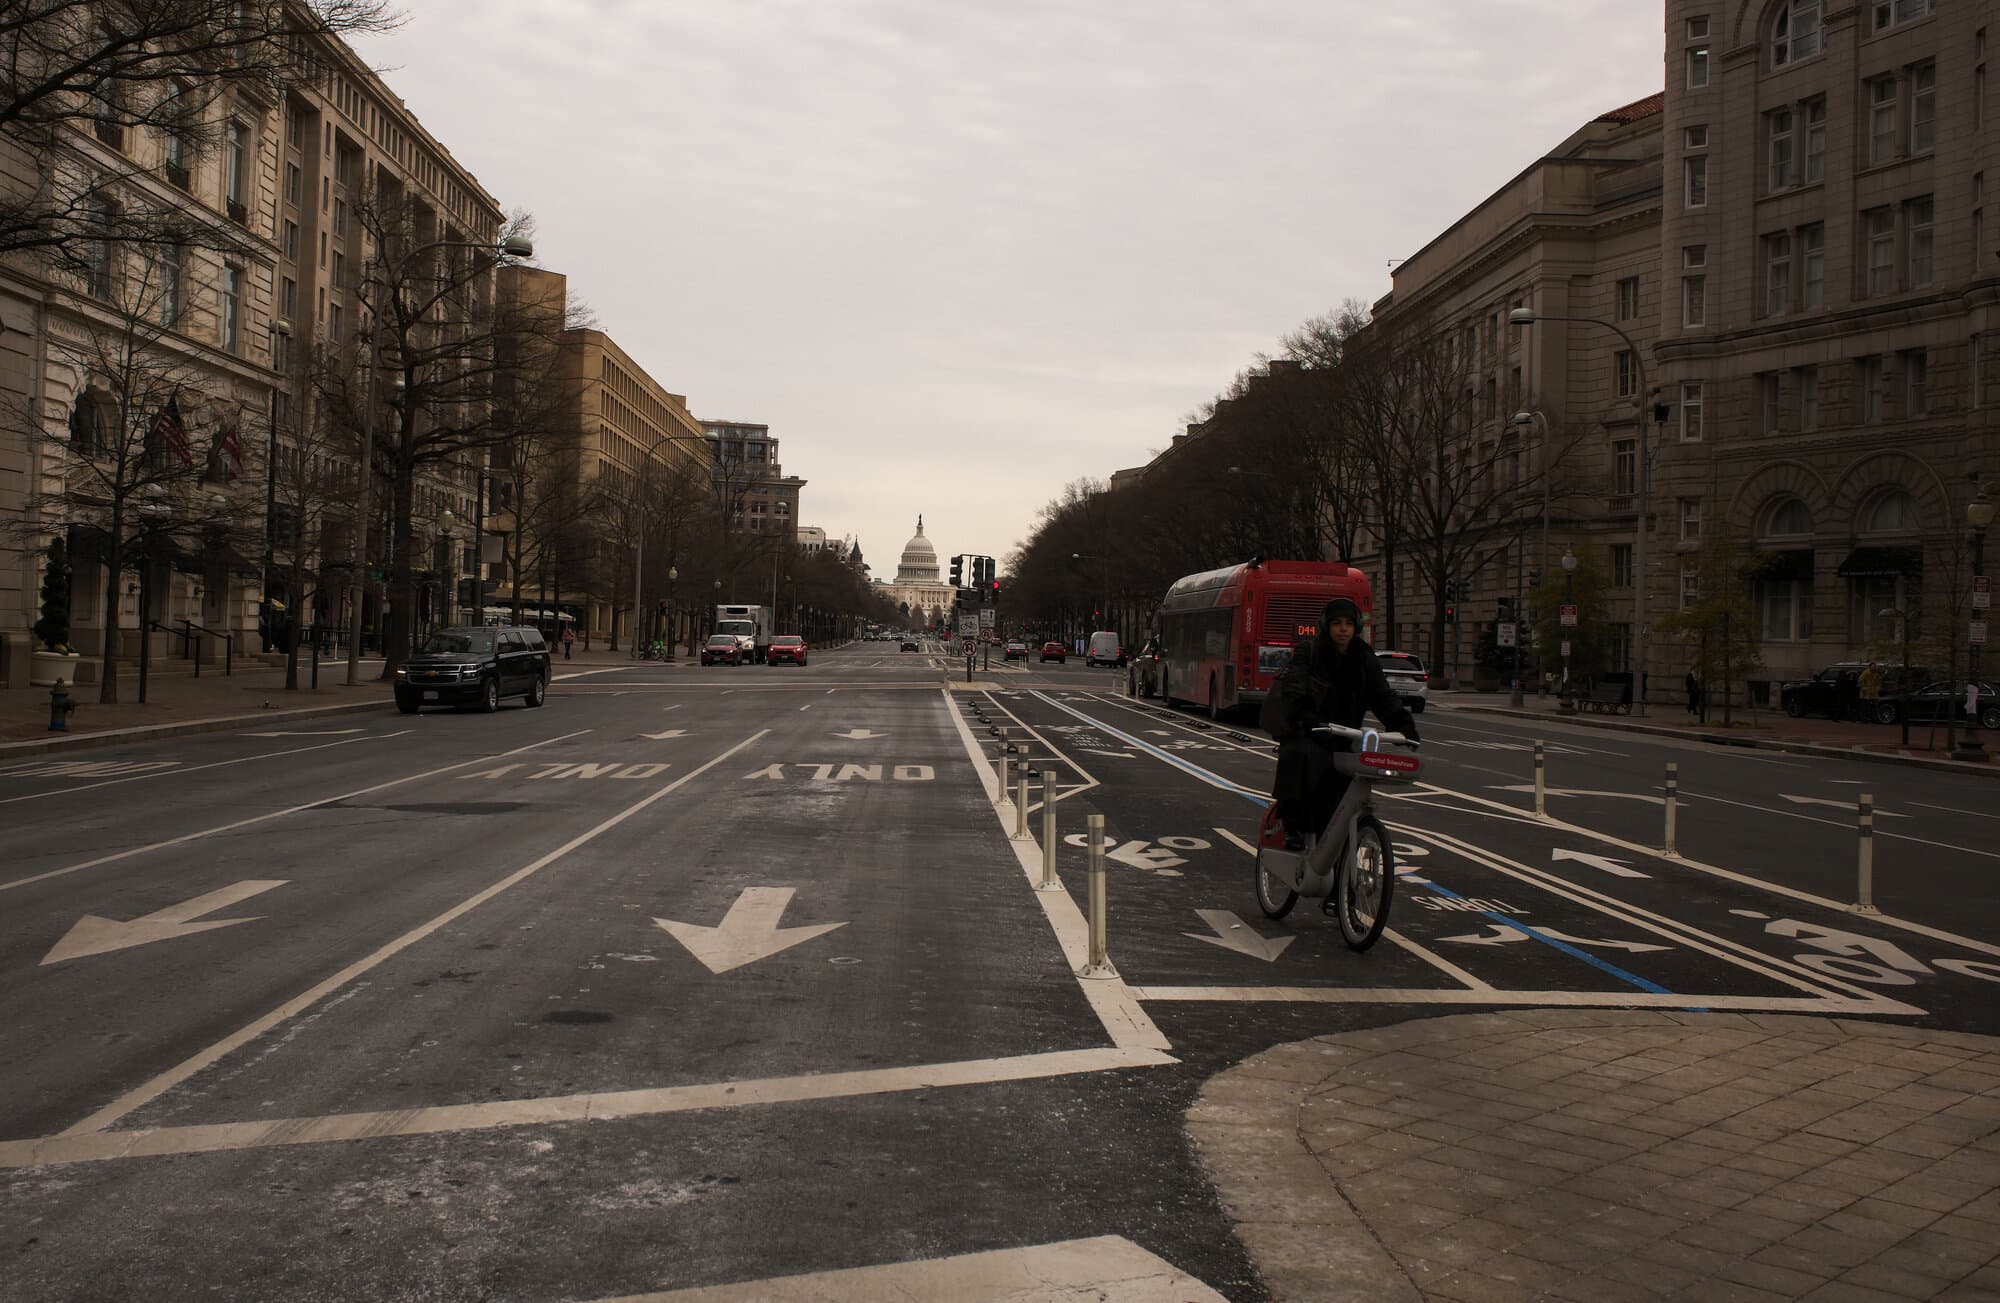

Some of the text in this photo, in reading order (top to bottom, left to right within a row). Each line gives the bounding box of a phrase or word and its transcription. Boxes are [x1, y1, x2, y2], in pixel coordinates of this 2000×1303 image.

[1298, 625, 1316, 637] D44
[456, 763, 672, 779] ONLY
[742, 763, 935, 780] ONLY
[1410, 896, 1532, 914] TURNS
